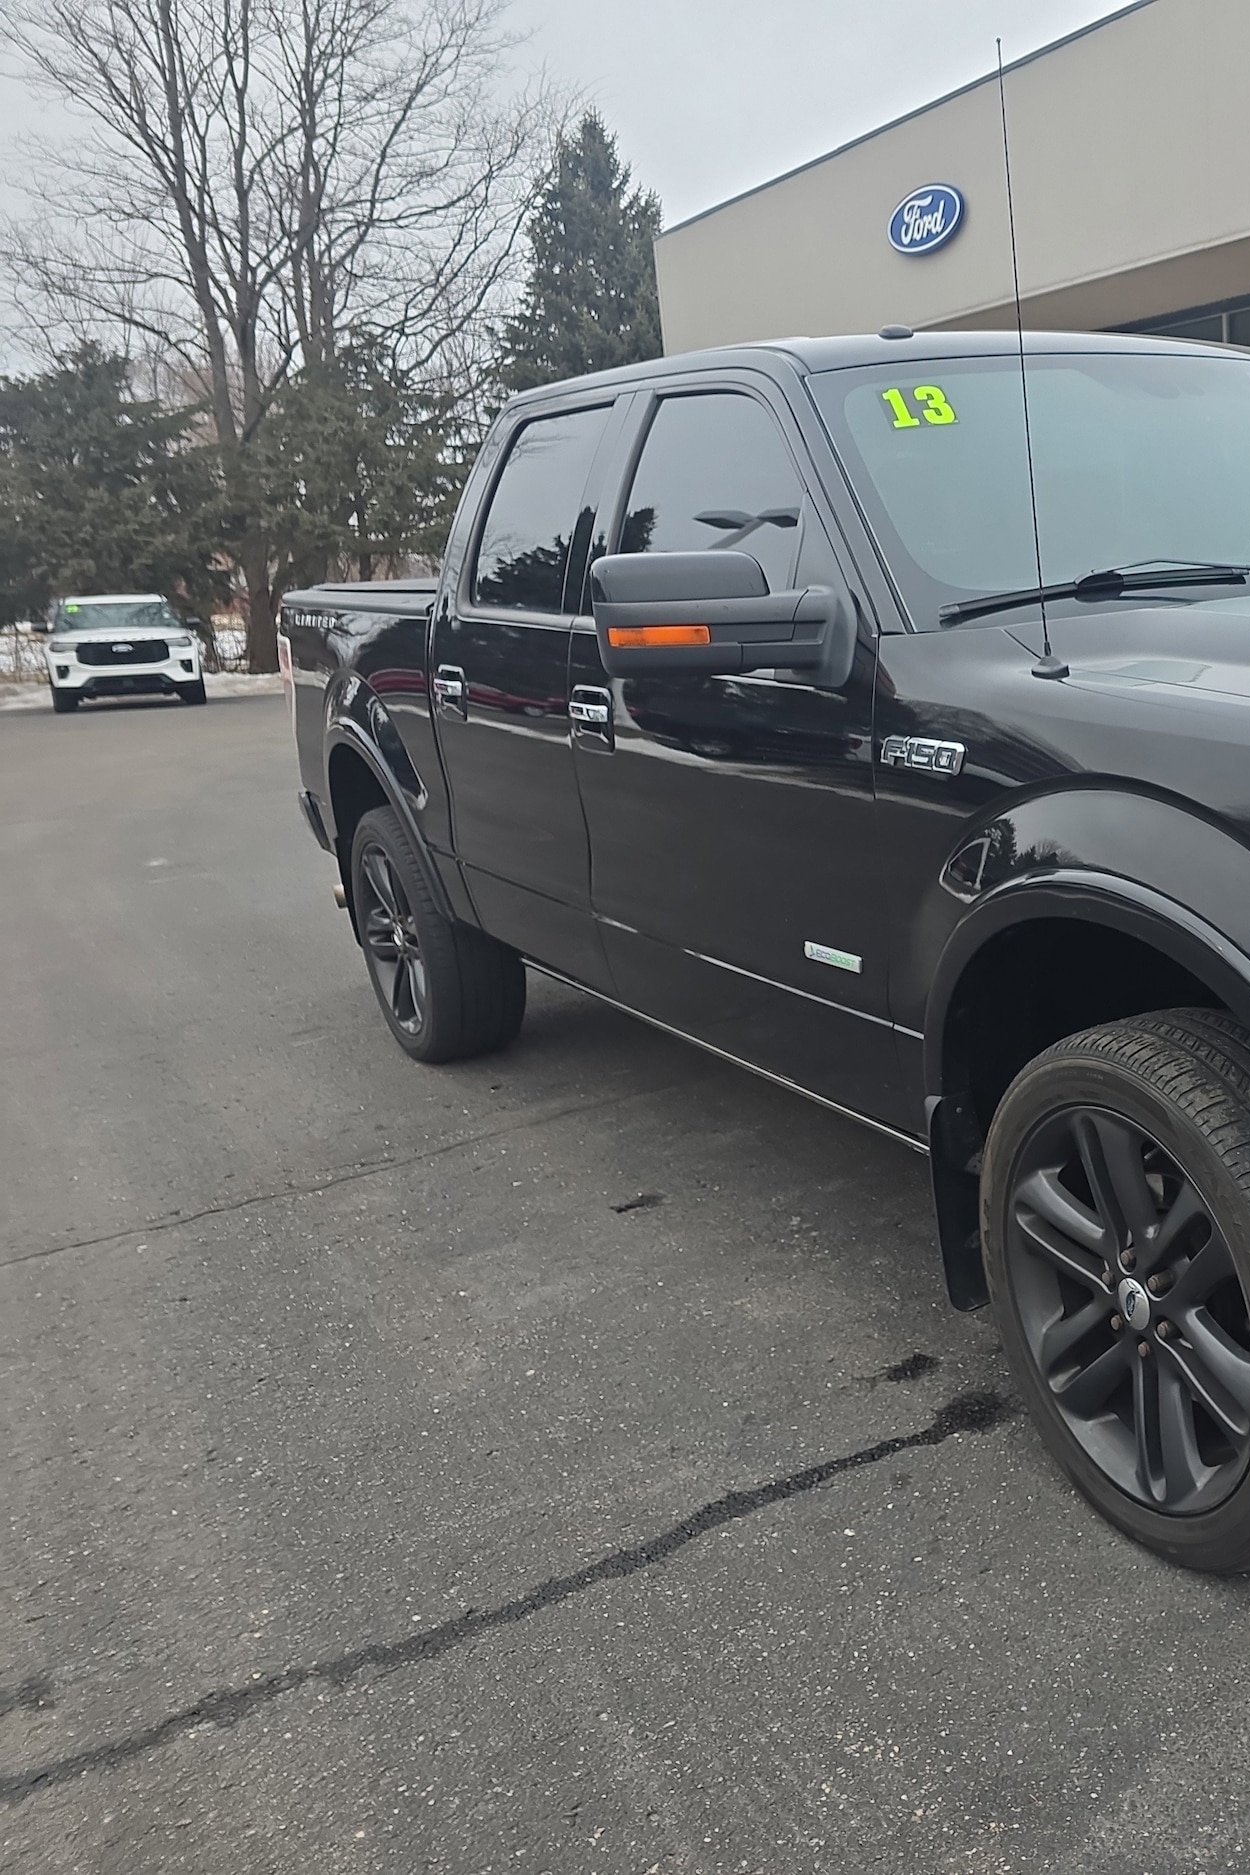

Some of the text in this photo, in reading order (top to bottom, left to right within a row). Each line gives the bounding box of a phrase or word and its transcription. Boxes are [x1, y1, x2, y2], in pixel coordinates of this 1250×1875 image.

[901, 194, 946, 246] Ford
[882, 385, 956, 428] 13
[294, 613, 338, 629] LIMITED
